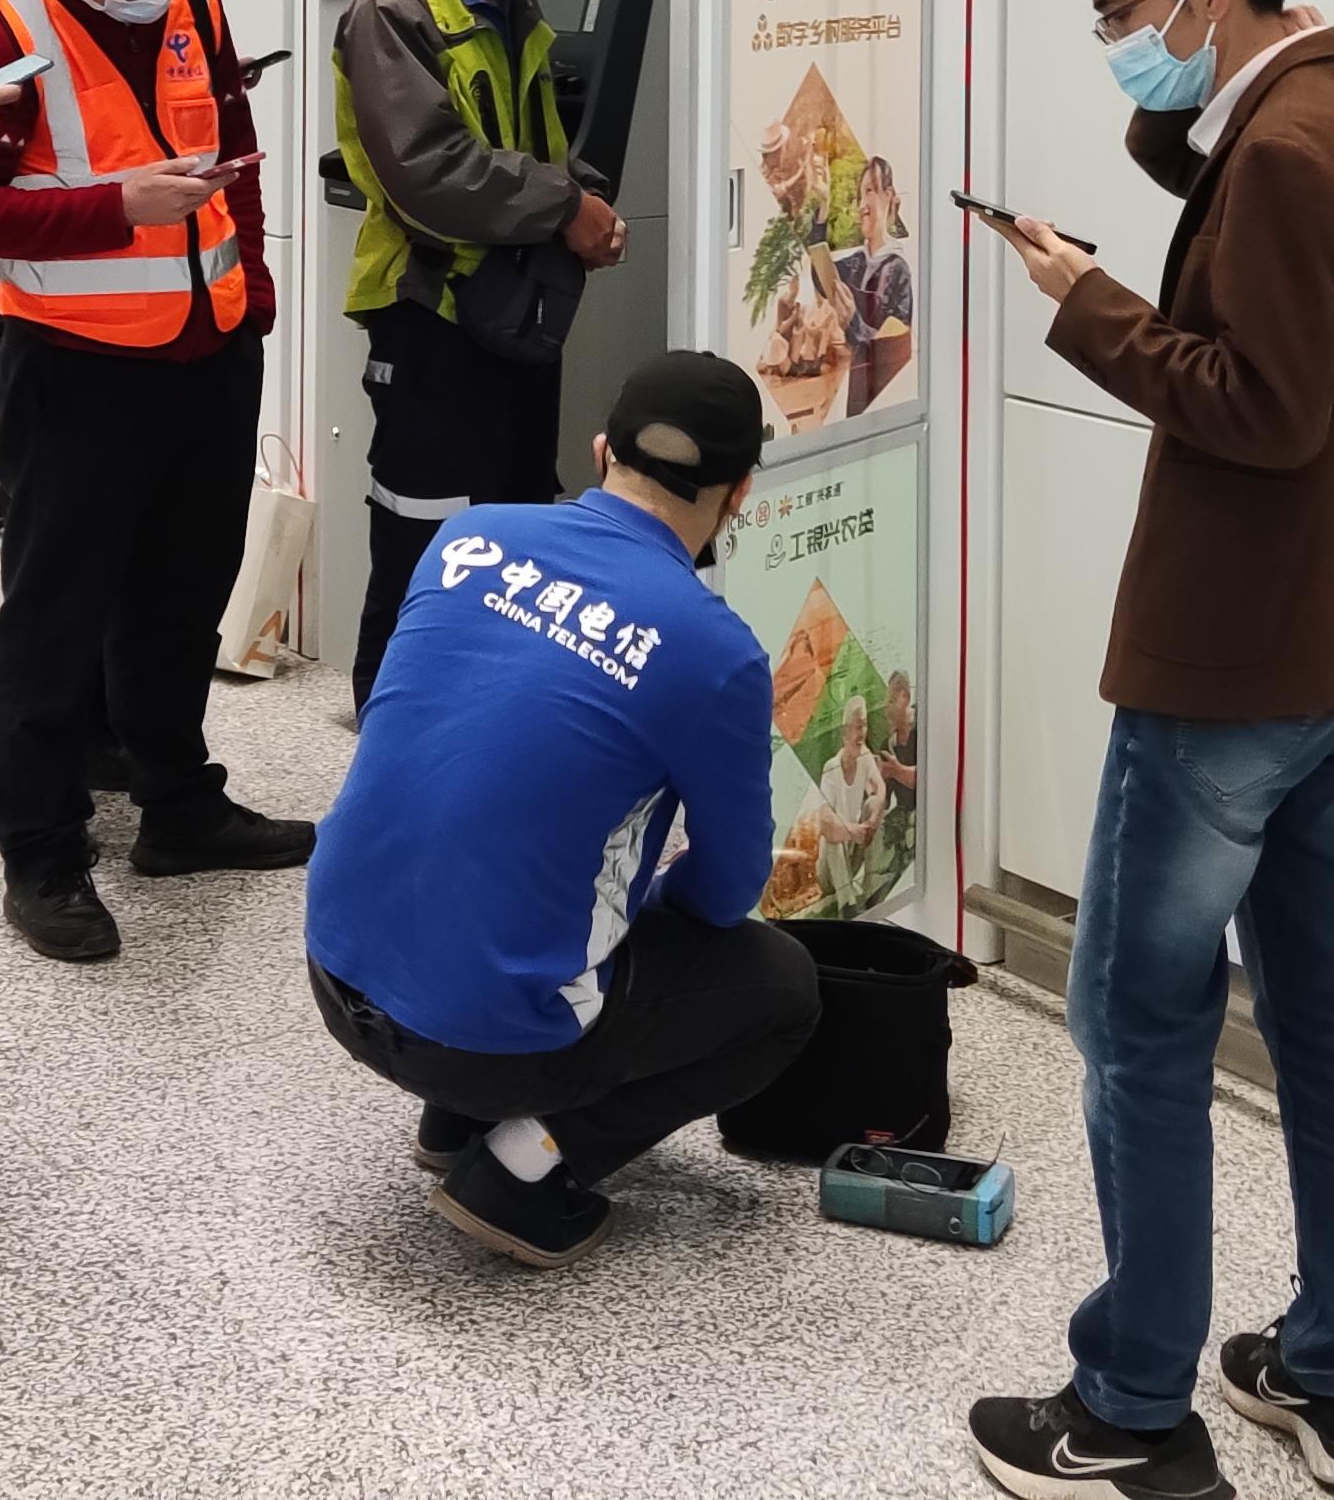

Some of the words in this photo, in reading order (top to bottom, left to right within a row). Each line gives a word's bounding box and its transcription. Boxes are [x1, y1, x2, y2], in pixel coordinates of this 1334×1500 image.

[483, 592, 542, 633] CHINA
[546, 622, 639, 691] TELECOM
[501, 558, 662, 671] 中国电信
